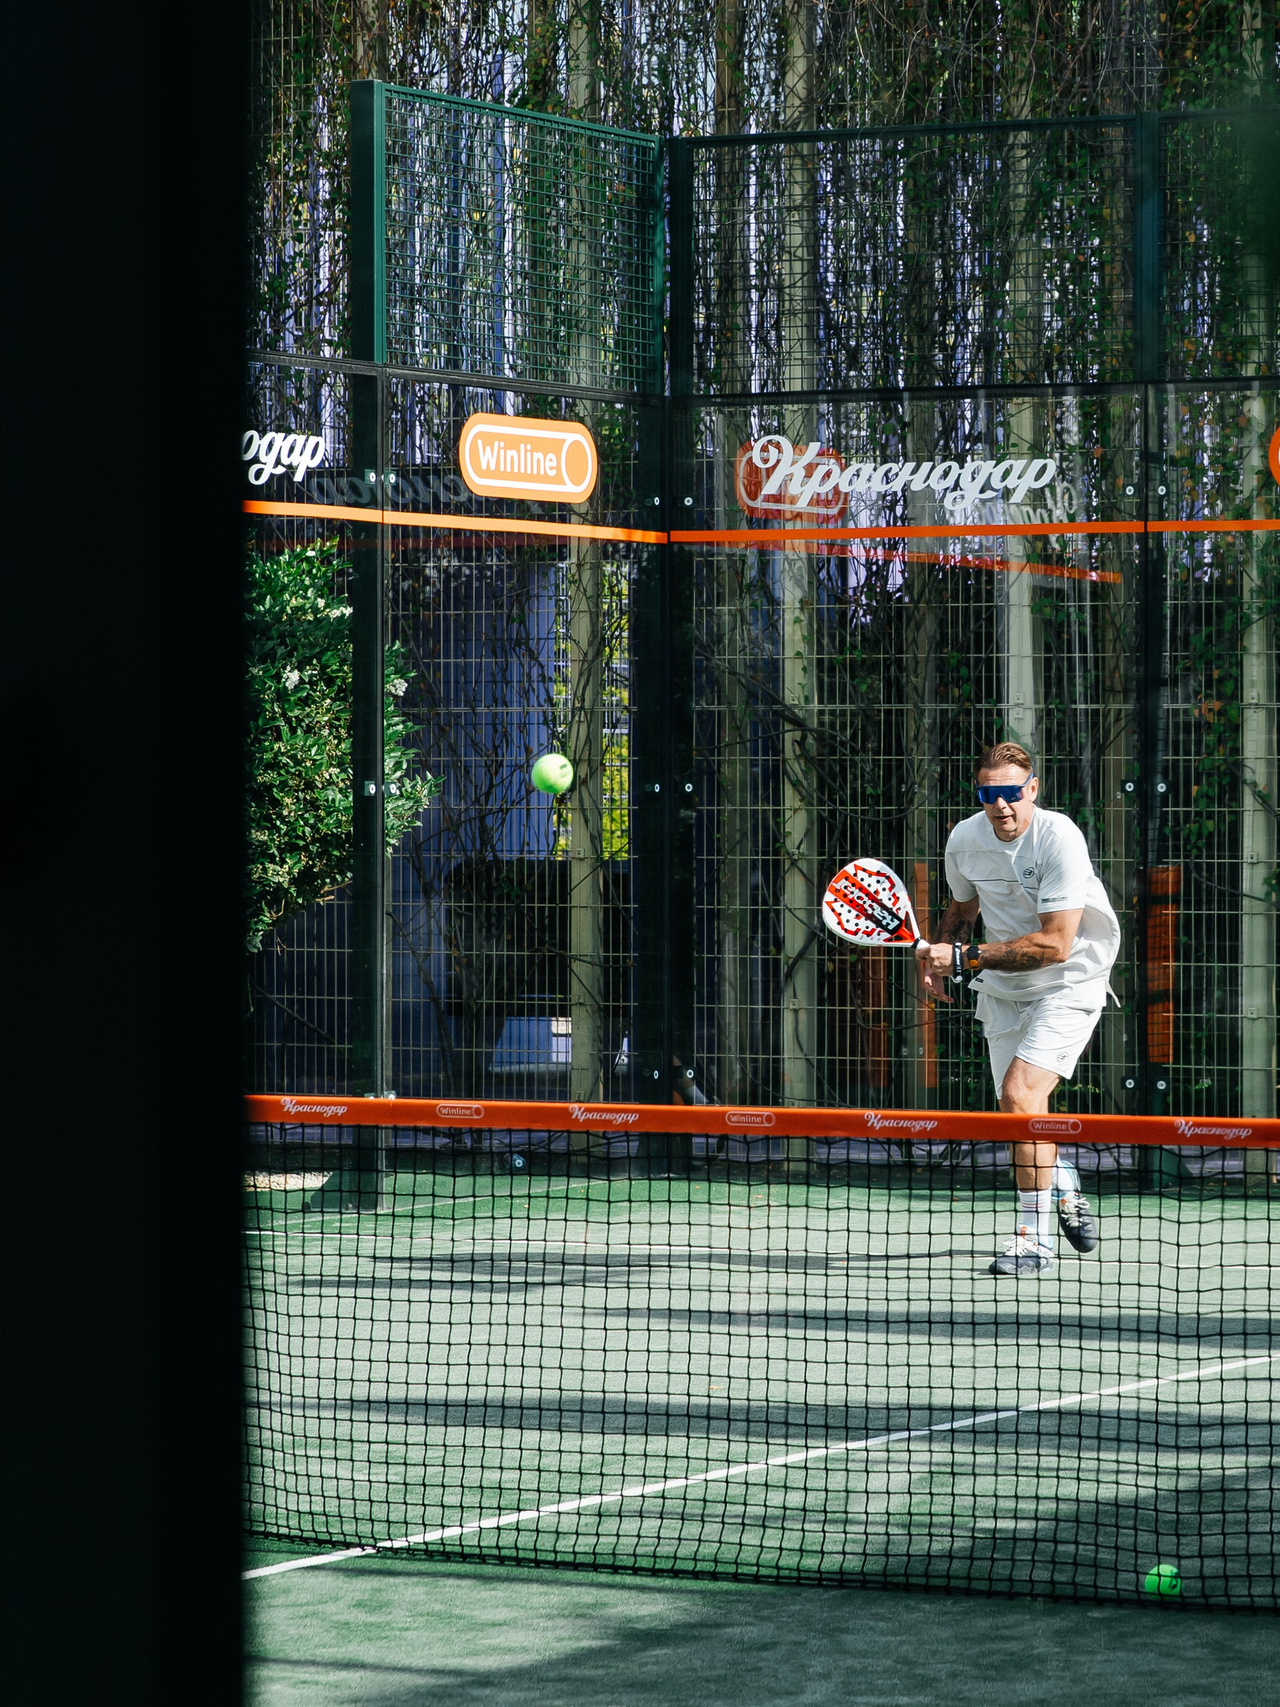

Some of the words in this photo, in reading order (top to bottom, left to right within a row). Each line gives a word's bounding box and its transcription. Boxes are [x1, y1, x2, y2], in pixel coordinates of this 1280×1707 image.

[477, 438, 558, 477] Winline
[752, 434, 1056, 511] Краснодар
[281, 1096, 348, 1118] Краснодар
[568, 1104, 640, 1125] Краснодар
[864, 1111, 938, 1132] Краснодар
